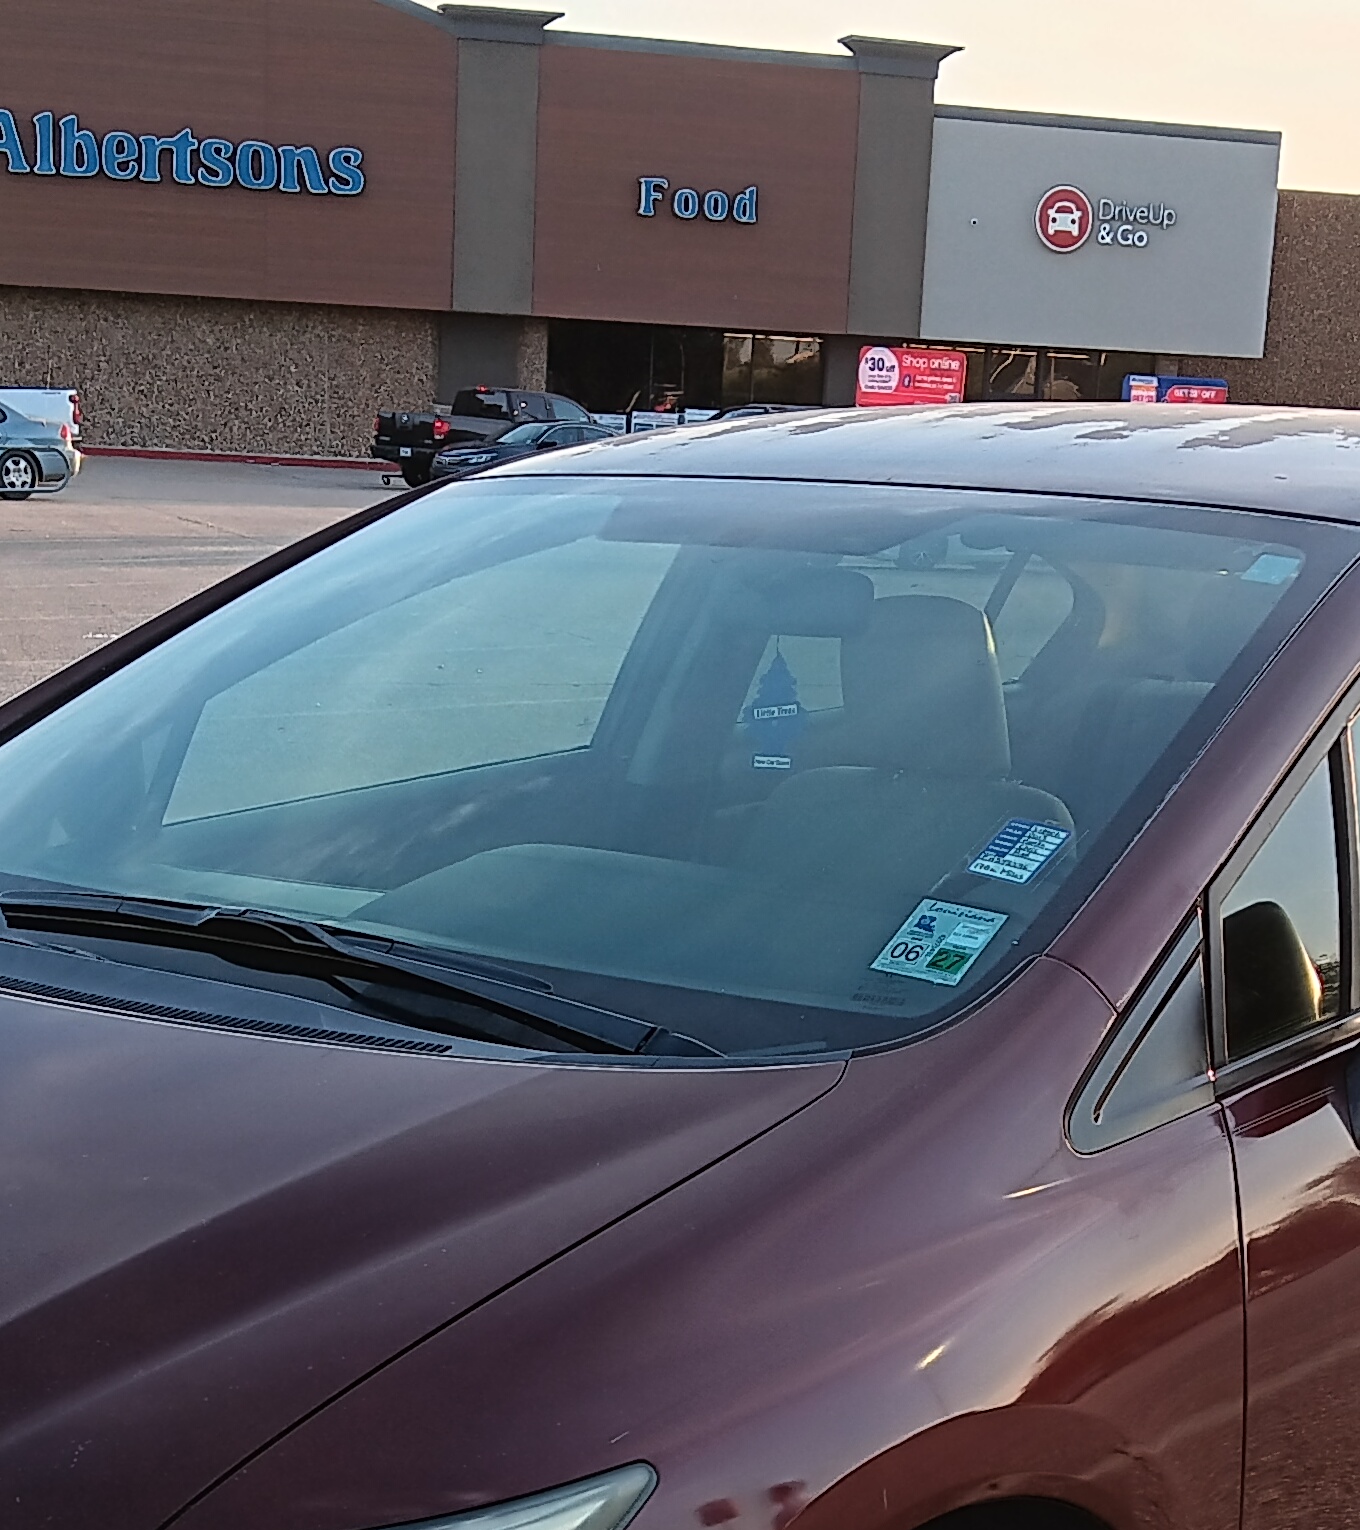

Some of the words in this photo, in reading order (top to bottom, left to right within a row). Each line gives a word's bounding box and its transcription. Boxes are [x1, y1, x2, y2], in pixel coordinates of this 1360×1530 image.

[637, 177, 757, 223] Food
[1098, 198, 1176, 230] DriveUp
[1097, 222, 1115, 245] &
[1116, 224, 1148, 247] Go
[902, 354, 928, 371] Shop
[929, 356, 961, 371] online
[890, 941, 924, 962] 06
[930, 950, 965, 970] 27
